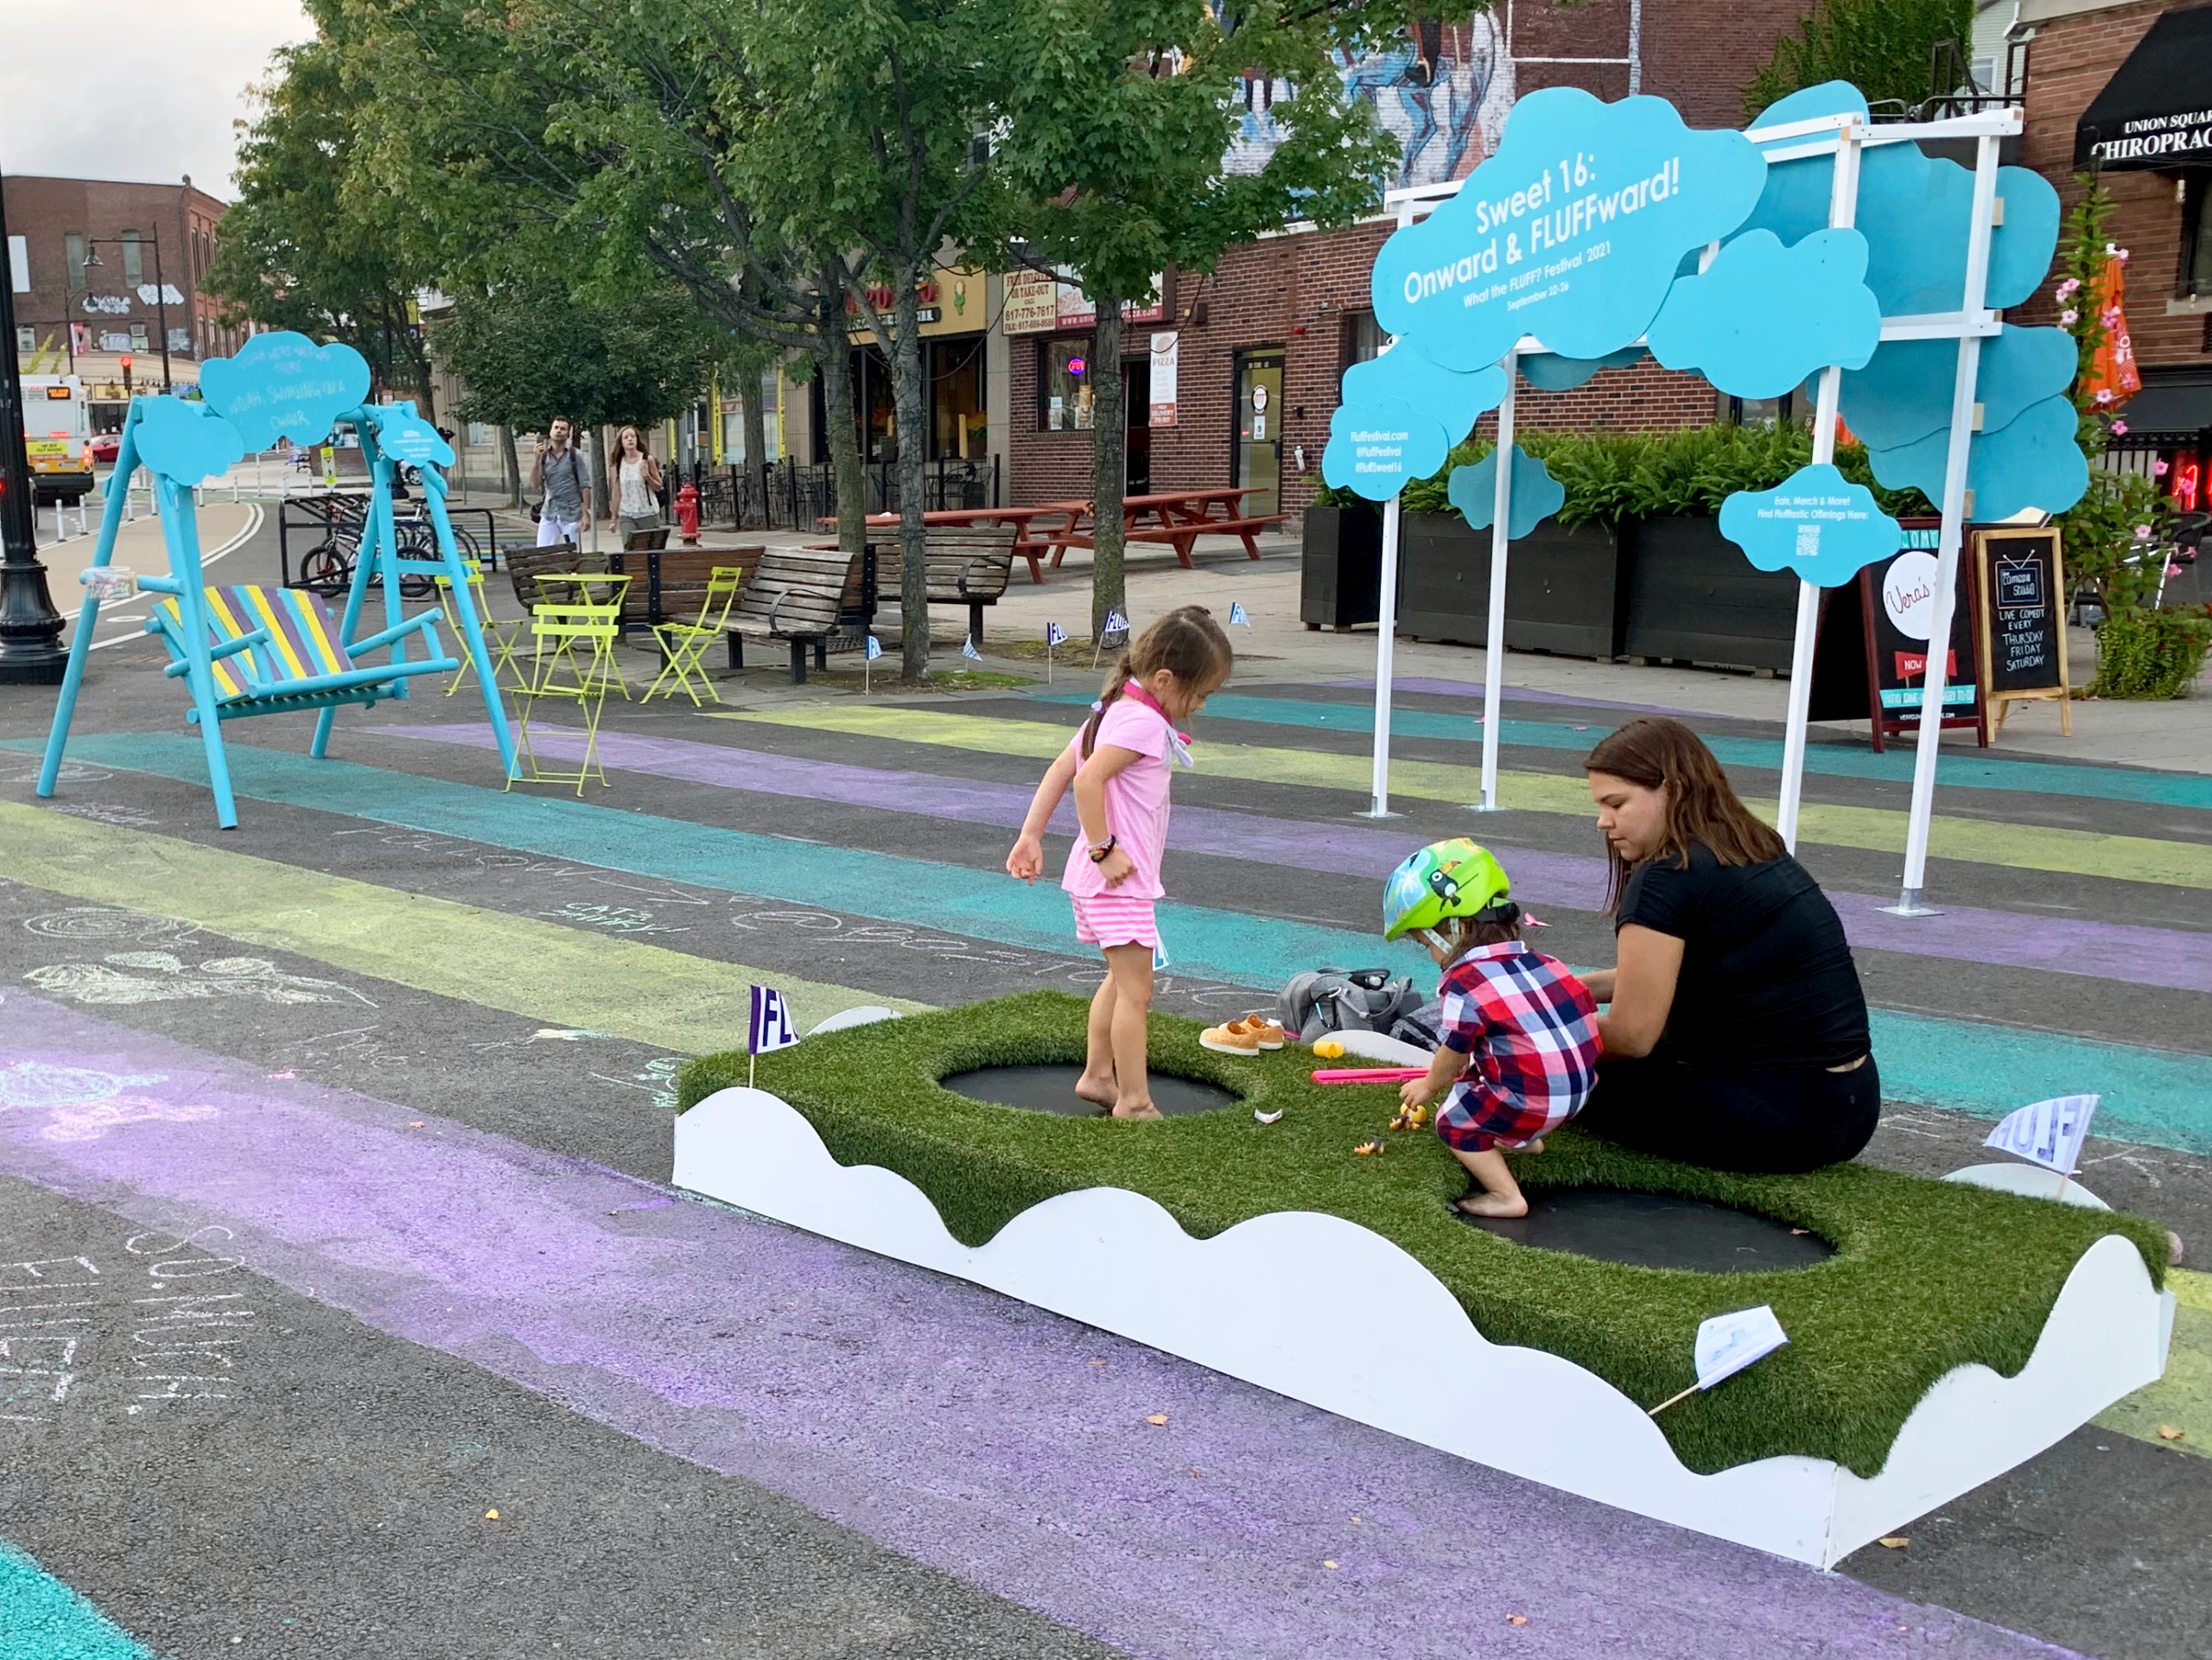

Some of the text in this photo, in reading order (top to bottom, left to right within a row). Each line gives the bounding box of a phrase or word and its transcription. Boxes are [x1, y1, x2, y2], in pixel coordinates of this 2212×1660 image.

[2126, 116, 2168, 134] UNION
[1477, 152, 1596, 234] Sweet 16:
[1404, 156, 1680, 304] Onward & FLUFFward!
[1464, 241, 1611, 308] What the FLUFF? Festival 2021
[1020, 284, 1049, 297] TAKE-OUT
[1507, 281, 1570, 312] September 22-26
[1006, 305, 1054, 321] 617-776-7617
[1005, 322, 1017, 333] FAX:
[1153, 357, 1174, 366] PIZZA
[270, 410, 311, 431] CHAIR
[1774, 496, 1851, 506] Eats, Merch & More!
[1758, 509, 1772, 518] Find
[1811, 509, 1846, 521] Offerings
[1847, 510, 1869, 520] Here:
[1999, 608, 2044, 620] LIVE COMEDY
[2008, 620, 2032, 631] EVERY
[2002, 630, 2044, 646] THURSDAY
[2011, 643, 2041, 657] FRIDAY
[1904, 660, 1922, 671] NOW
[2006, 655, 2044, 671] SATURDAY
